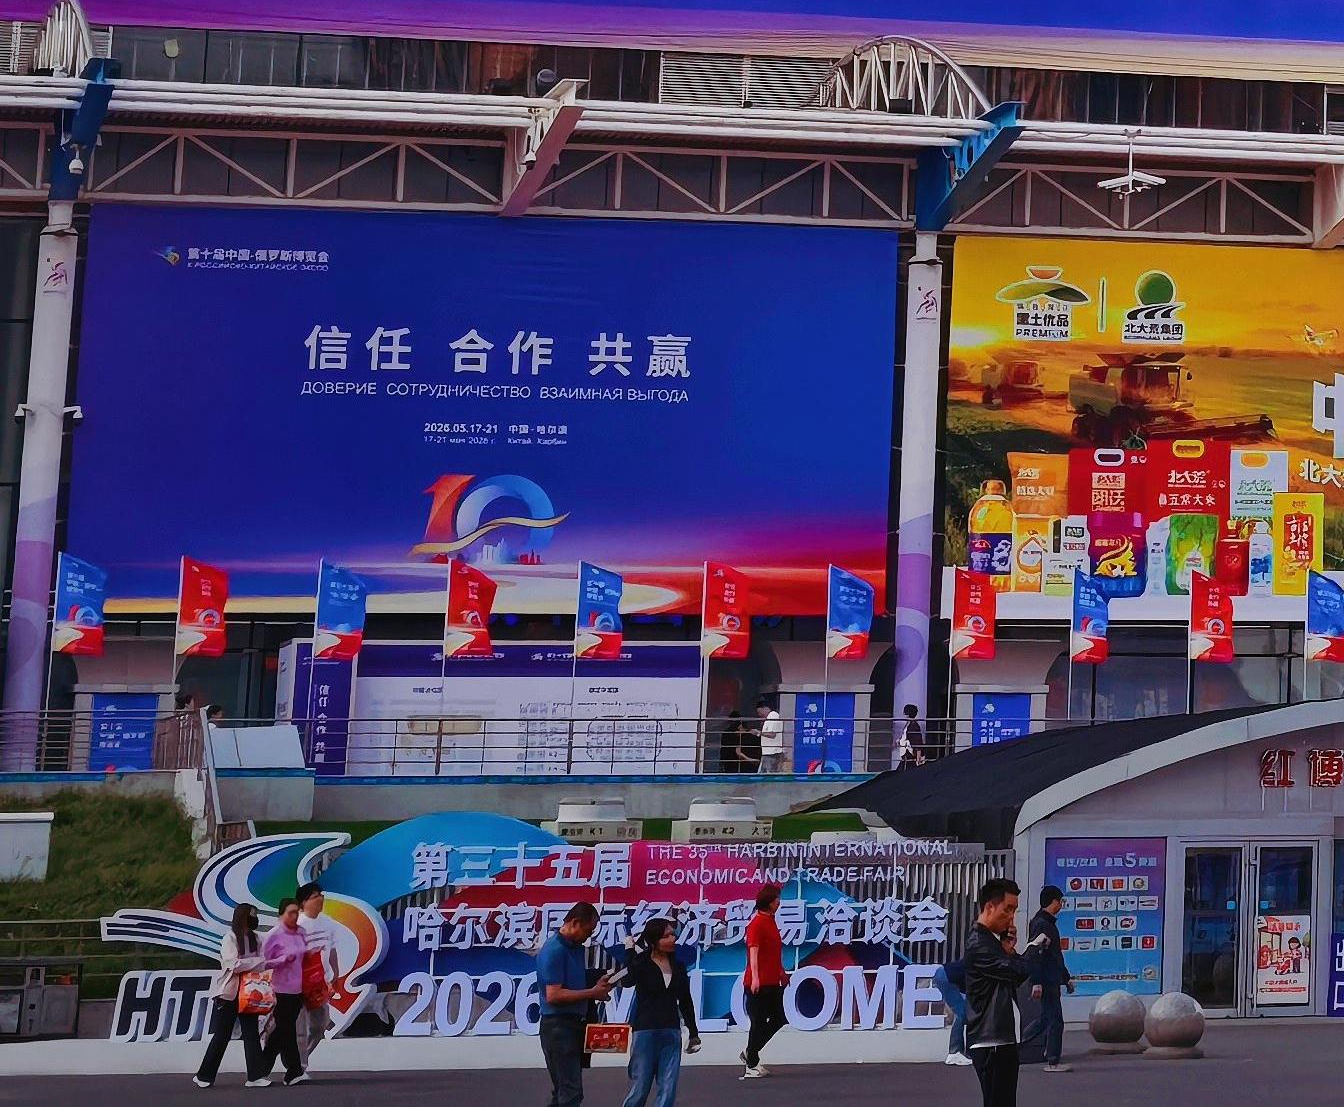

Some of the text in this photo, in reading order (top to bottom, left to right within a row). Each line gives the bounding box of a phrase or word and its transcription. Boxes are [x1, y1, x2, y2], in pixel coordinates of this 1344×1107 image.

[304, 325, 692, 378] 信任 合作 共赢
[301, 380, 689, 403] ДОВЕРИЕ СОТРУДНИЧЕСТВО ВЗАИМНАЯ ВЫГОДА
[409, 841, 632, 890] 第三十五届
[647, 844, 683, 860] THE
[727, 843, 798, 858] HARBIN
[800, 840, 954, 857] INTERNATIONAL
[645, 864, 906, 886] ECONOMIC AND TRADE FAIR
[395, 970, 542, 1038] 2026
